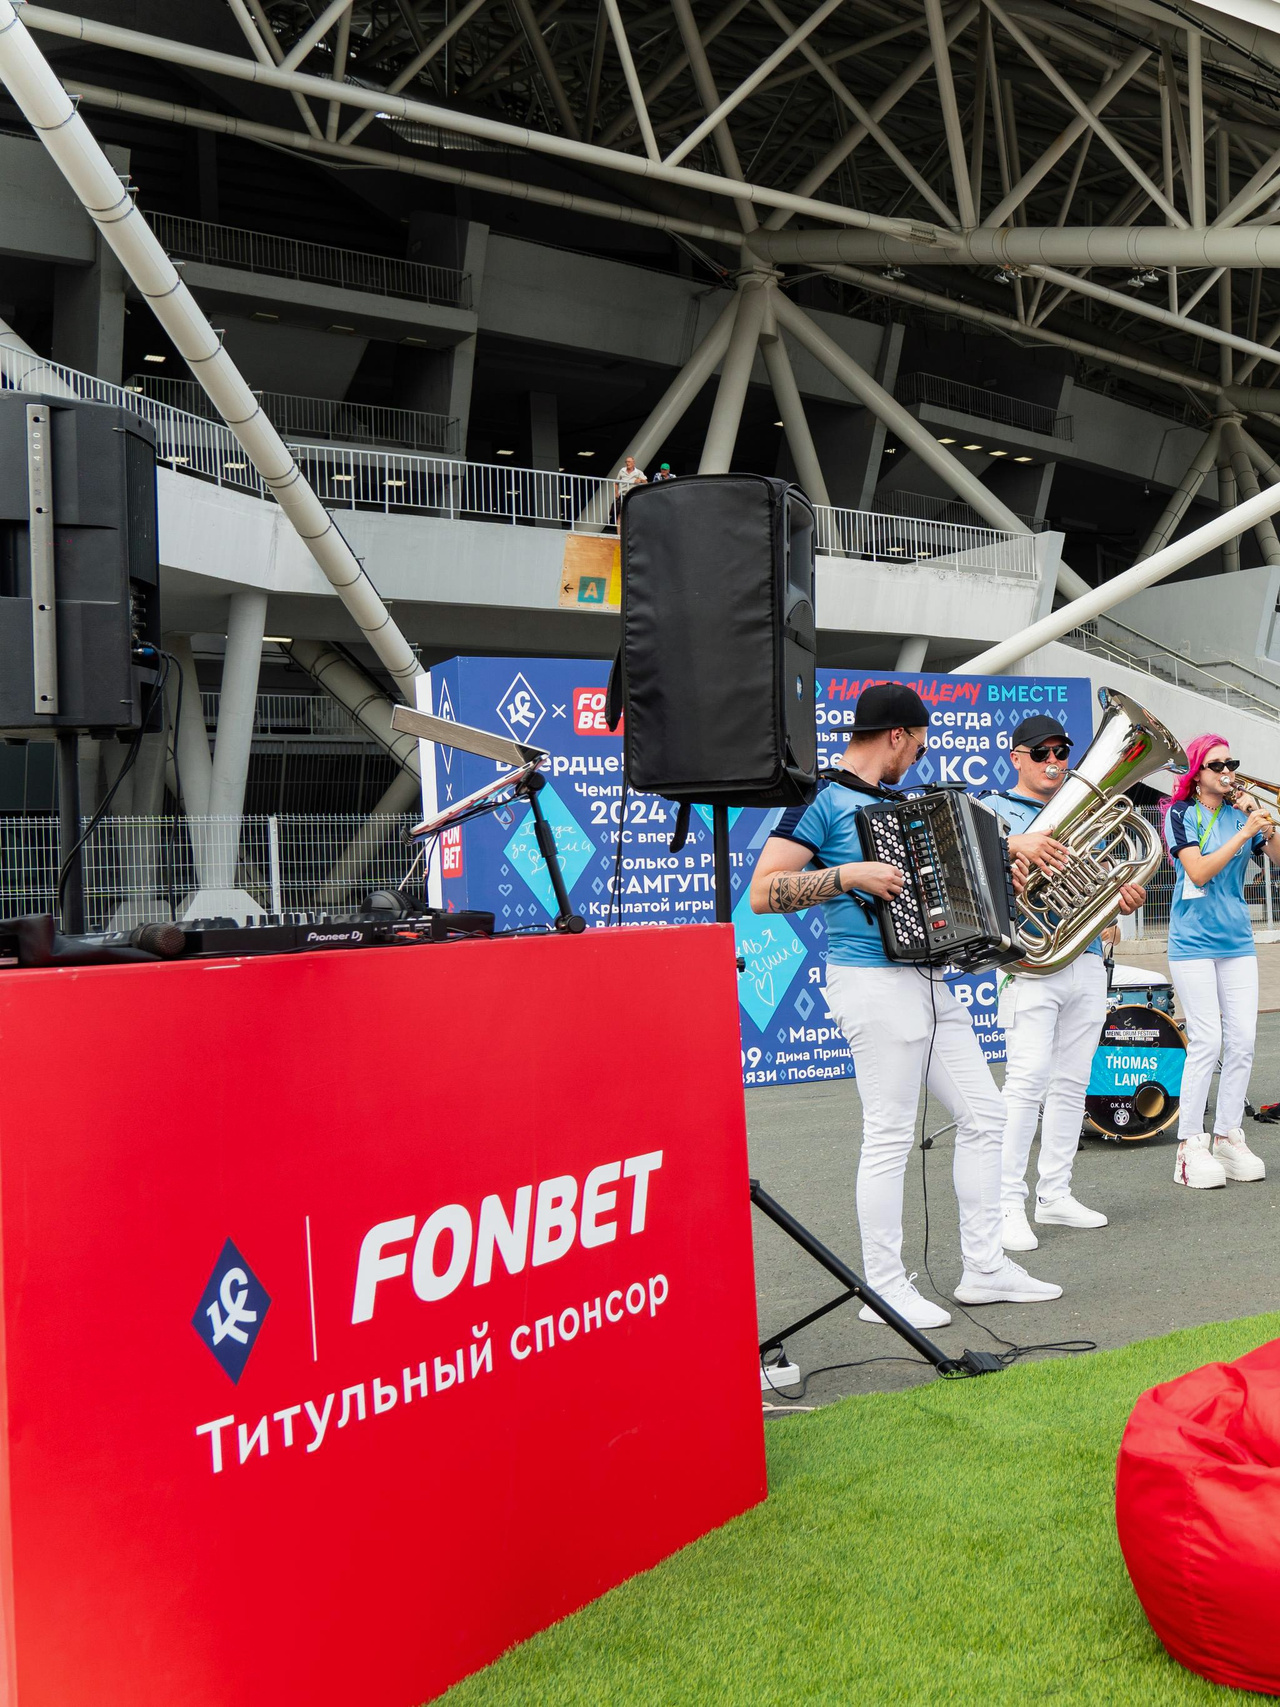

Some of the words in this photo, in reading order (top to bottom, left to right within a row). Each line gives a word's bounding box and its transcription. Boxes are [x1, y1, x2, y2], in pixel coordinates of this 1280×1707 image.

[584, 581, 599, 599] A
[577, 693, 607, 711] FO
[987, 684, 1069, 703] ВМЕСТЕ
[577, 711, 607, 730] BE
[930, 710, 992, 730] сегда
[924, 730, 990, 752] обеда
[539, 752, 625, 777] ердце!
[939, 755, 989, 786] КС
[590, 800, 667, 824] 2024
[610, 830, 633, 844] КС
[637, 831, 697, 845] вперд
[443, 845, 461, 870] BET
[611, 855, 680, 870] Только
[684, 856, 695, 868] в
[589, 897, 670, 917] Крылатой
[674, 899, 714, 915] игры
[306, 932, 350, 942] Pioneer
[976, 1031, 1006, 1043] Побе
[776, 1051, 810, 1065] Дима
[813, 1047, 853, 1061] Прищ
[1105, 1055, 1158, 1070] THOMAS
[742, 1069, 777, 1084] язи
[787, 1063, 846, 1080] Победа!
[1114, 1073, 1148, 1087] LANG
[350, 1150, 664, 1325] FONBET
[195, 1321, 494, 1475] Титульный
[509, 1273, 670, 1361] спонсор
